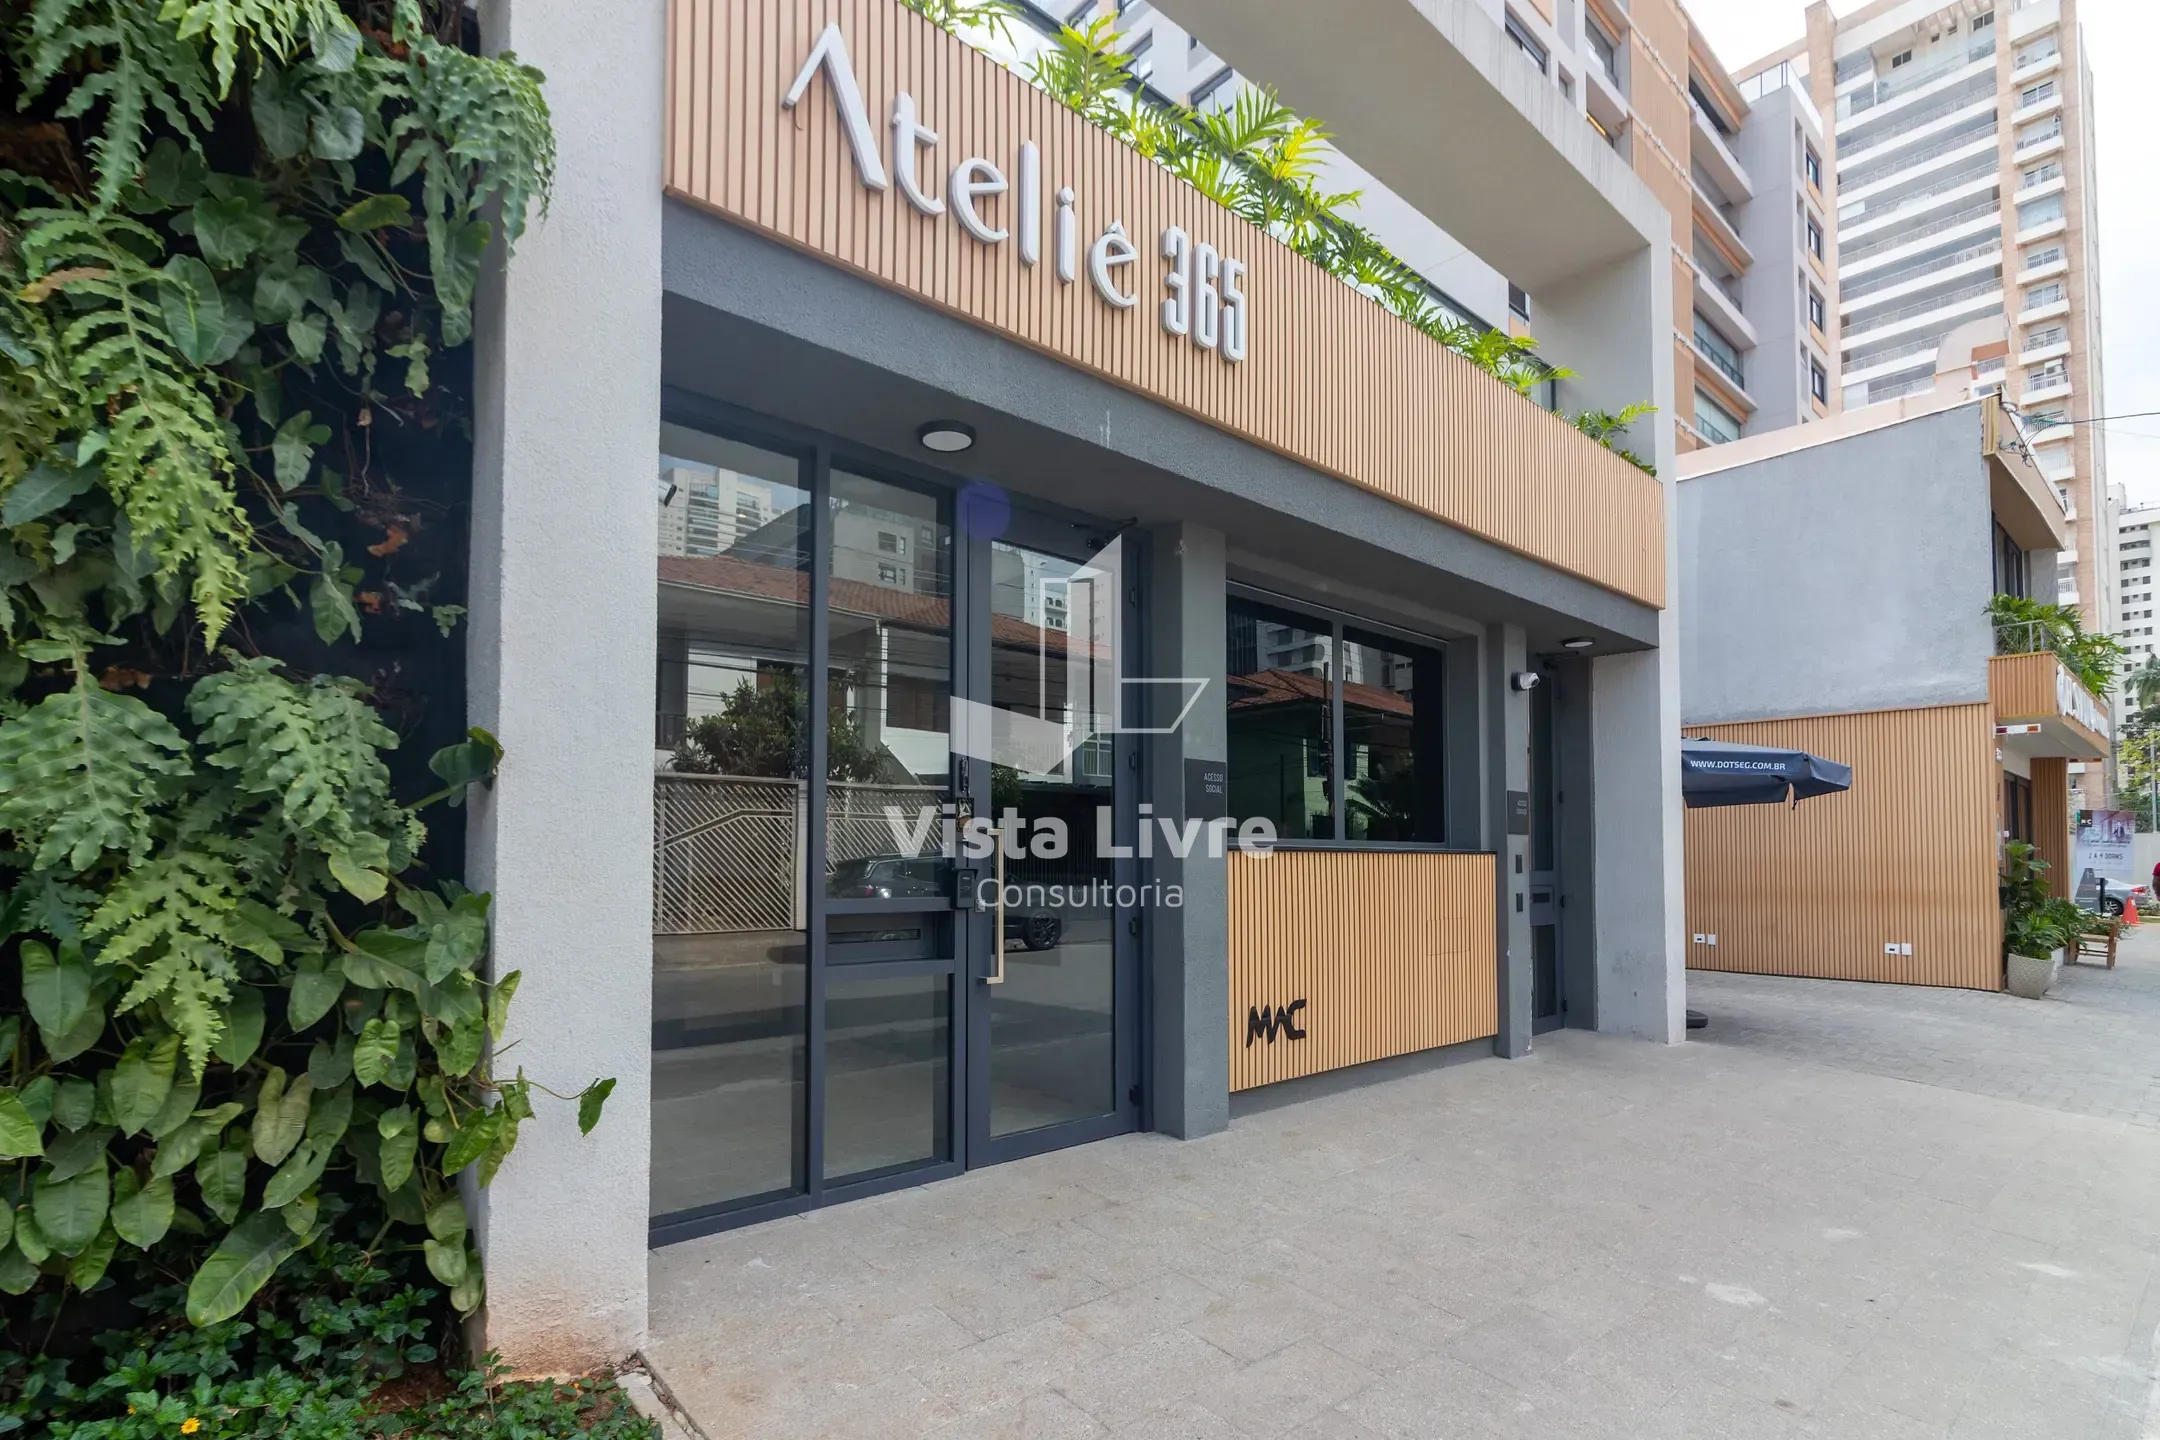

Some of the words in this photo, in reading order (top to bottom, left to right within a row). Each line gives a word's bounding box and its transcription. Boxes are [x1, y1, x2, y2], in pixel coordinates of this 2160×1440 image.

[780, 22, 1139, 309] Ateliê
[1161, 224, 1246, 364] 365
[1690, 760, 1786, 770] WWW.DOTSEG.COM.BR
[1203, 772, 1224, 782] ACESSO
[1205, 784, 1222, 793] SOCIAL
[1246, 998, 1307, 1048] MAC
